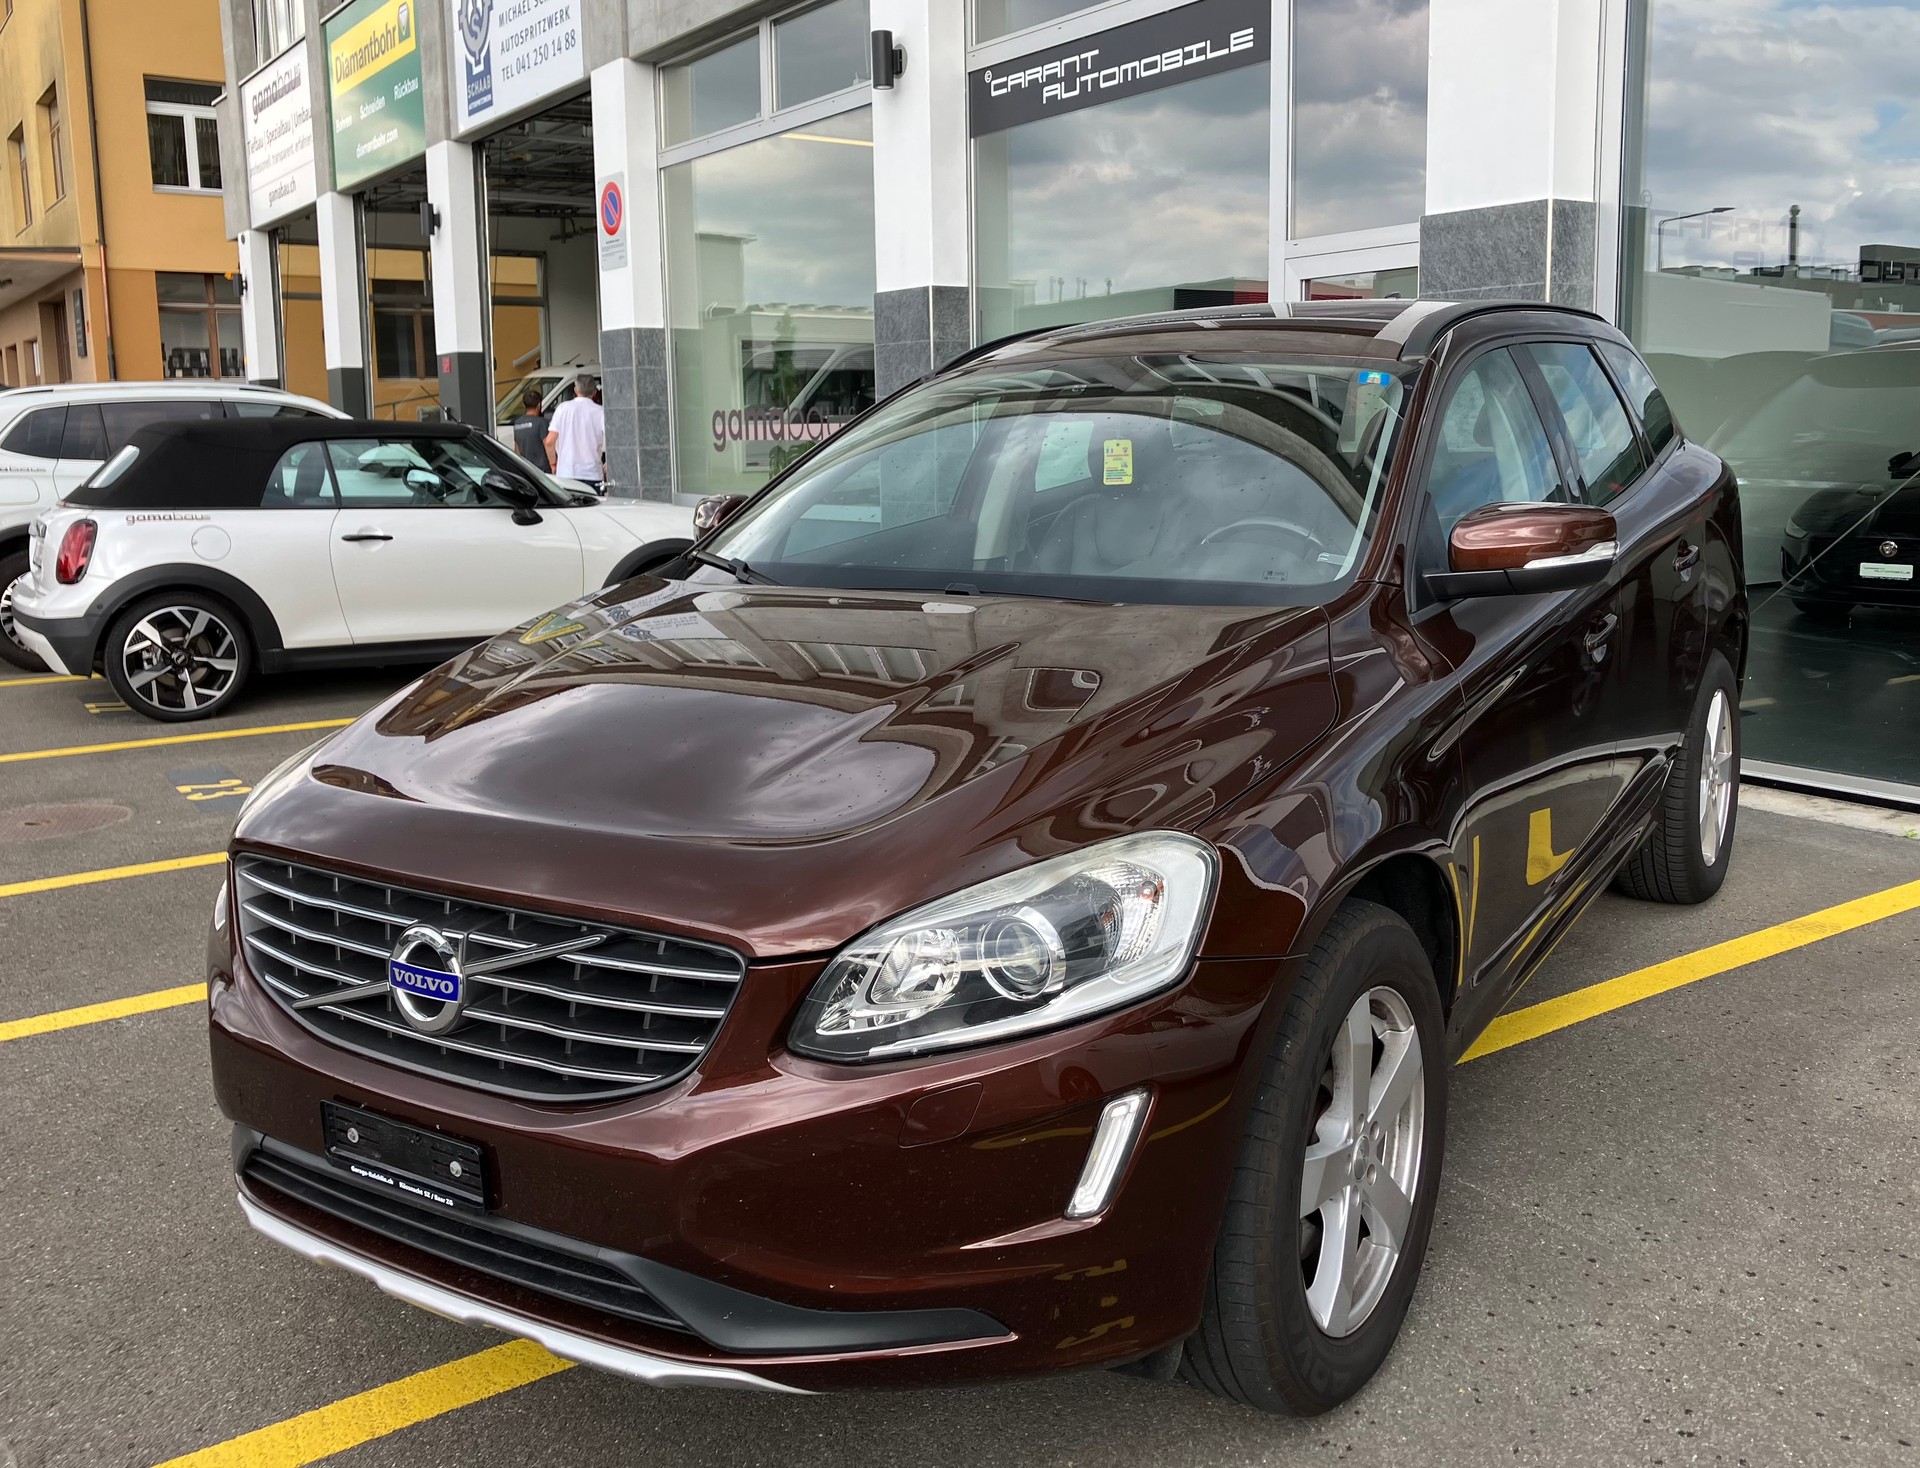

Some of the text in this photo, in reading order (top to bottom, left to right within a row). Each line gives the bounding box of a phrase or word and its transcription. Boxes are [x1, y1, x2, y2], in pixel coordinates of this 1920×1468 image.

[498, 0, 531, 28] MICHAEL
[500, 5, 571, 56] AUTOSPRITZWERK
[335, 22, 396, 84] Diamantbohr
[501, 28, 577, 82] TEL 041 250 14 88
[1043, 27, 1254, 104] AUTOMOBILE
[394, 77, 418, 101] Rückbau
[392, 967, 454, 994] VOLVO
